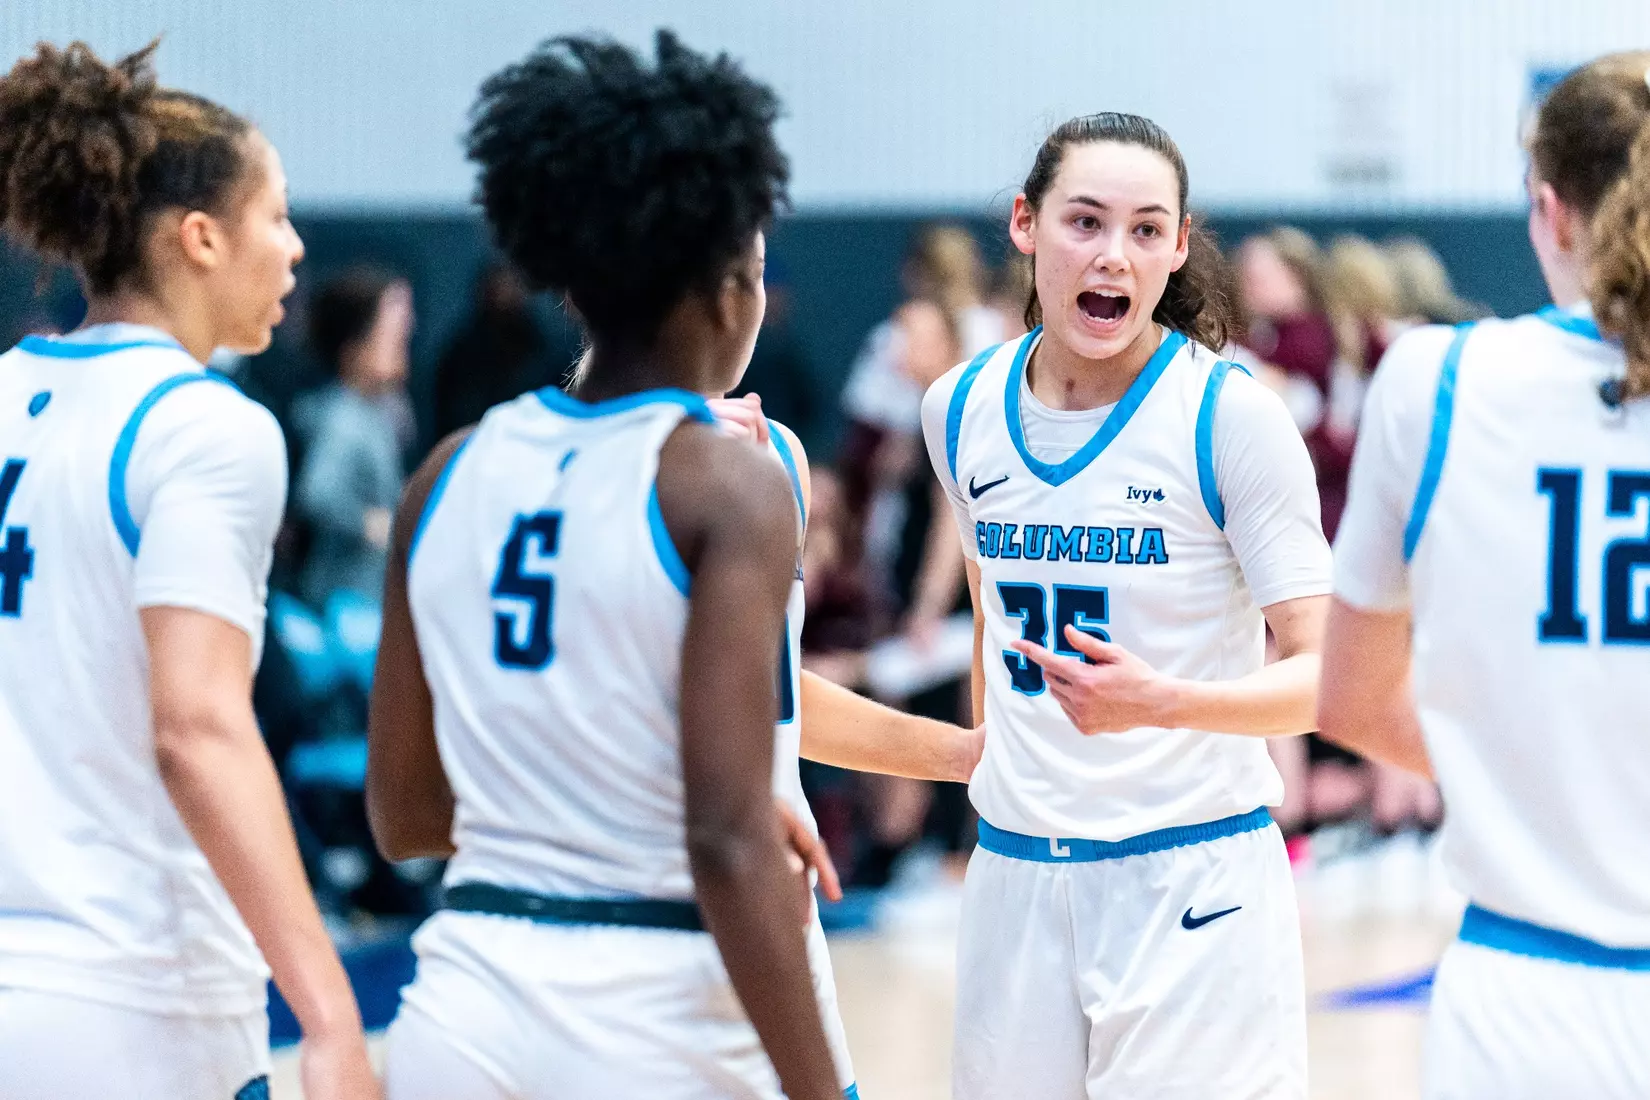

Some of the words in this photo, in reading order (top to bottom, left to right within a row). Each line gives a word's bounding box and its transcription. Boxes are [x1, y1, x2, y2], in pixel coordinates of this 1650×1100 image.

[976, 520, 1169, 565] COLUMBIA
[1127, 486, 1152, 503] Ivy
[490, 510, 565, 672] 5
[1537, 467, 1650, 646] 12
[996, 581, 1112, 697] 35
